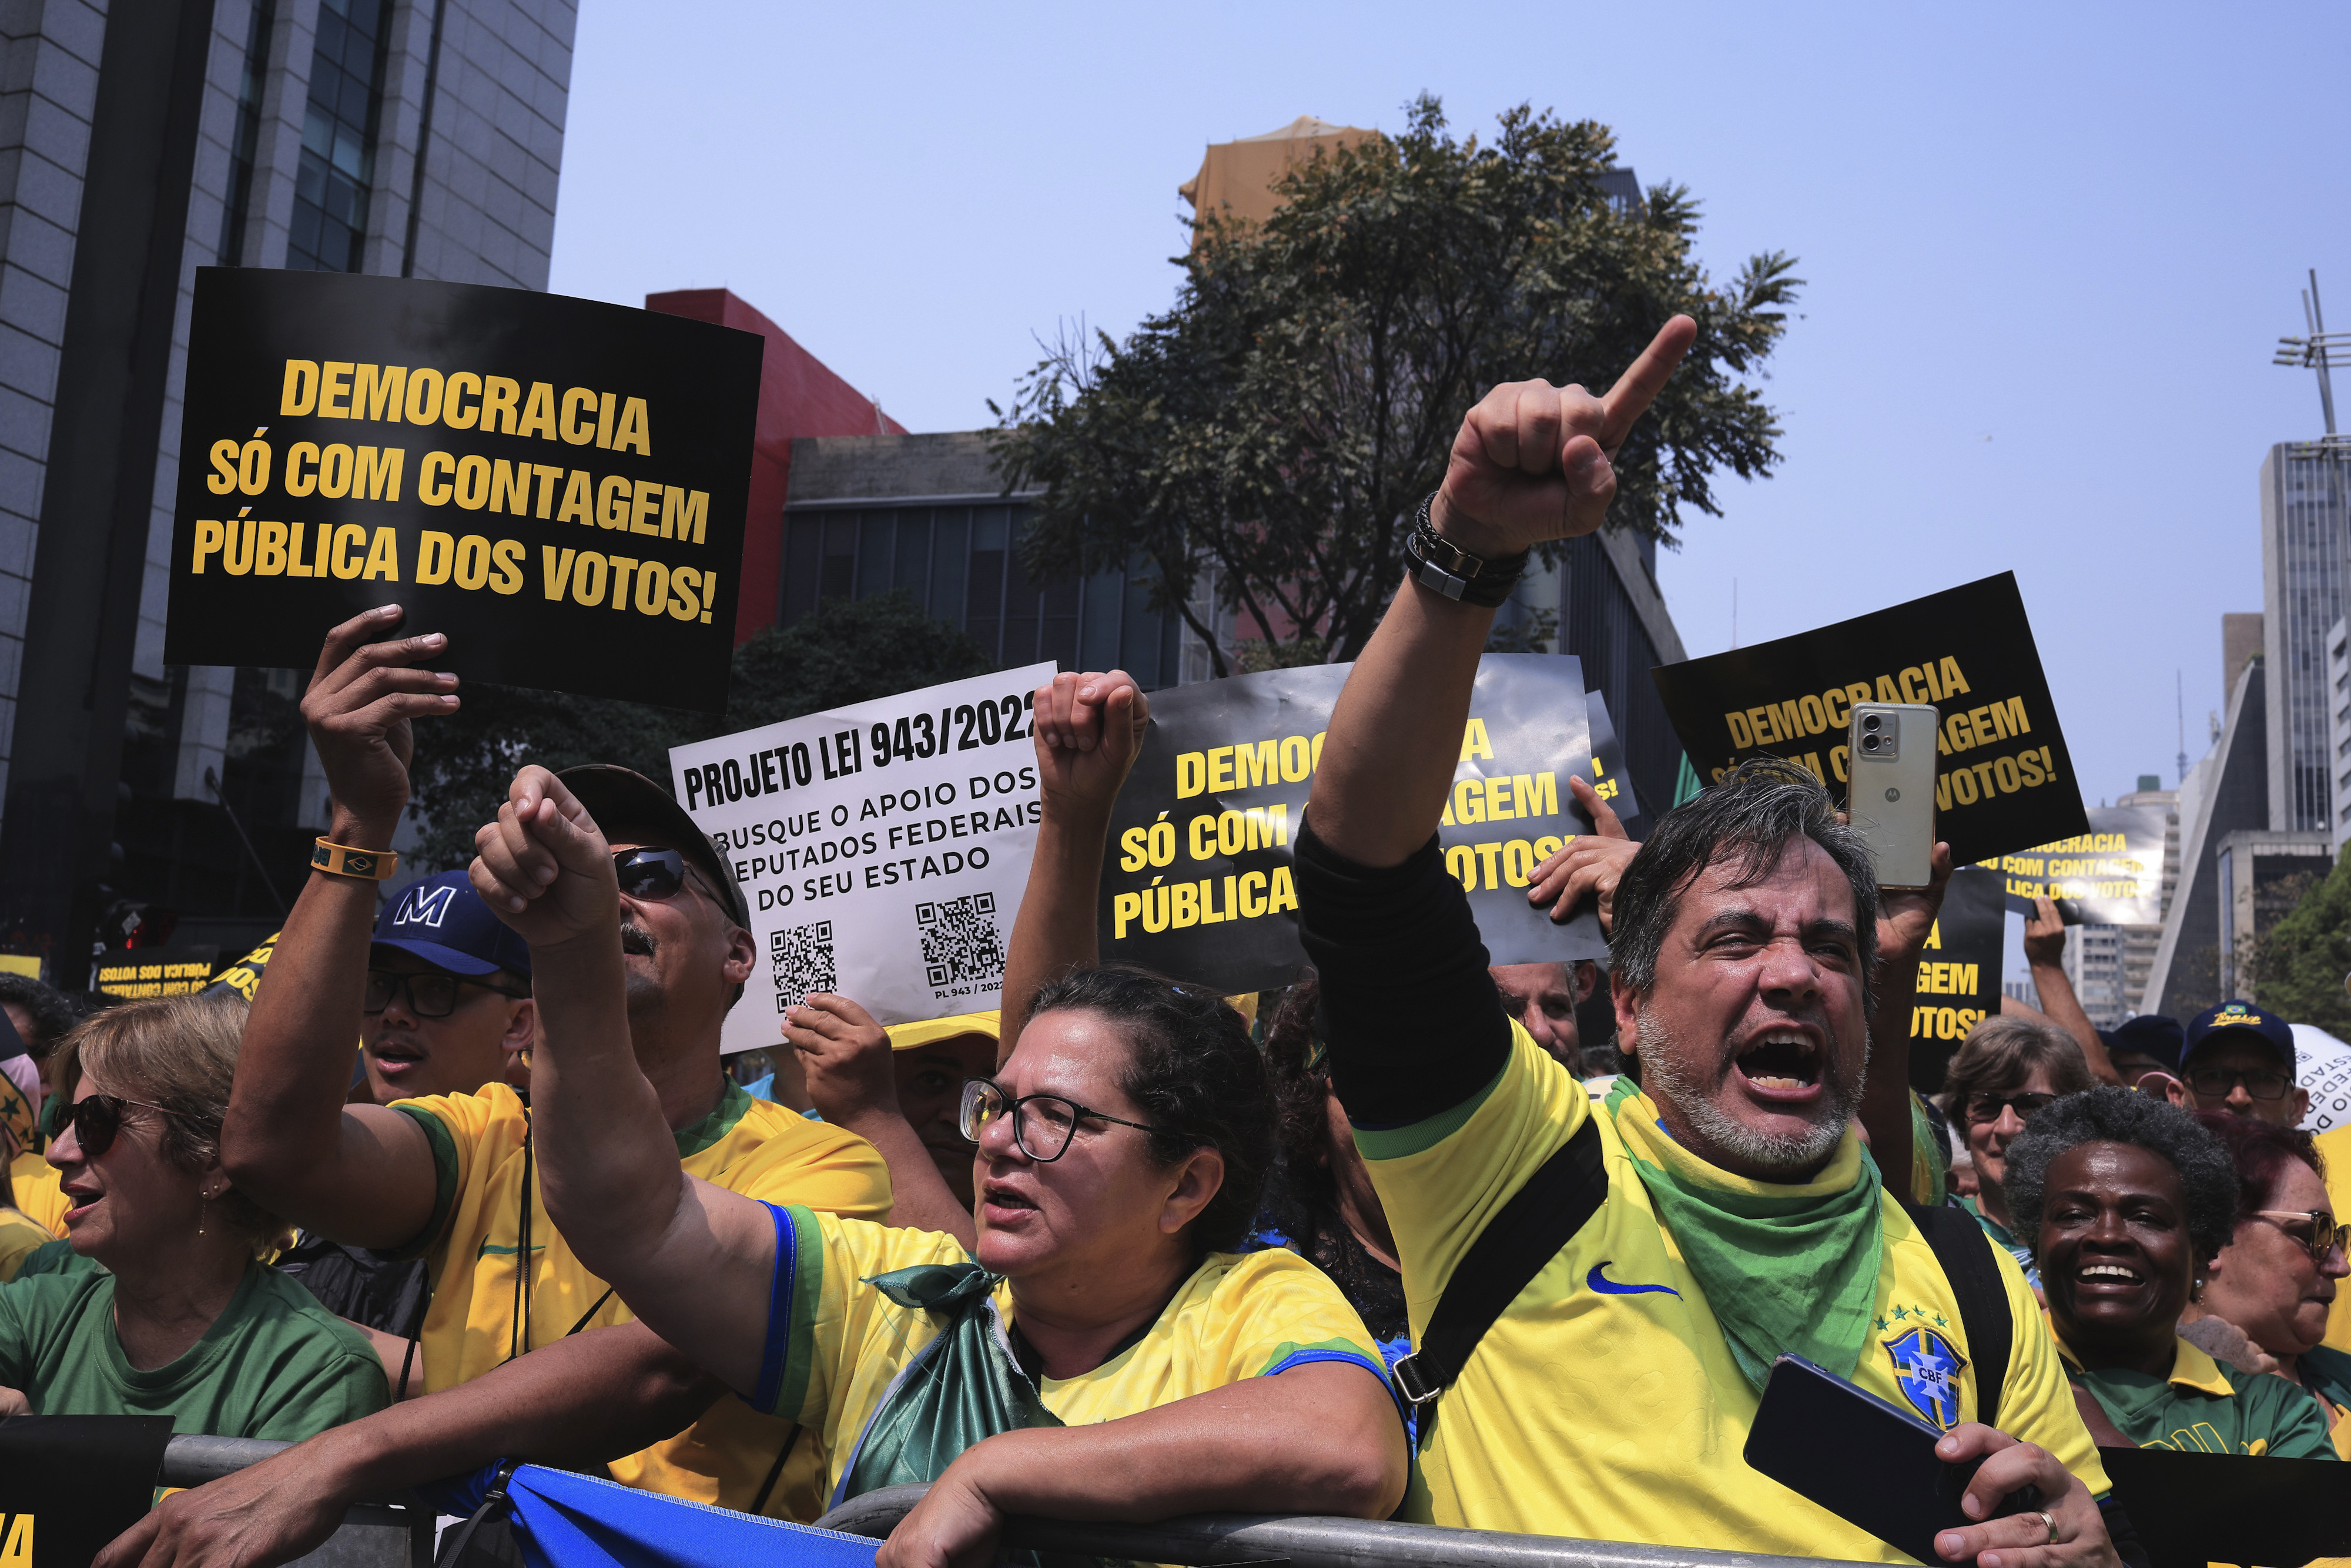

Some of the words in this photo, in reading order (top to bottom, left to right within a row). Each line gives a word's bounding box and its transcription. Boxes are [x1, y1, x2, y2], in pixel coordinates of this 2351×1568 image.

[280, 359, 651, 456] DEMOCRACIA
[207, 427, 271, 496] SÓ
[284, 441, 404, 502] COM
[418, 451, 709, 544] CONTAGEM
[192, 507, 398, 582] PÚBLICA
[416, 530, 525, 595] DOS
[542, 545, 717, 624] VOTOS!
[684, 741, 813, 812] PROJETO
[819, 729, 862, 780] LEI
[714, 810, 821, 852] BUSQUE
[831, 805, 848, 827] O
[860, 782, 956, 822] APOIO
[970, 767, 1036, 800] DOS
[735, 832, 878, 883] EPUTADOS
[889, 800, 1041, 850] FEDERAIS
[1121, 810, 1176, 872] SÓ
[1188, 803, 1287, 861] COM
[758, 885, 793, 912] DO
[804, 871, 852, 901] SEU
[866, 847, 990, 889] ESTADO
[2002, 856, 2044, 877] COM
[2006, 877, 2045, 900] LICA
[393, 886, 457, 927] M
[1114, 866, 1298, 939] PÚBLICA
[935, 990, 949, 999] PL
[951, 986, 971, 997] 943
[974, 984, 977, 994] /
[1918, 1367, 1942, 1383] CBF
